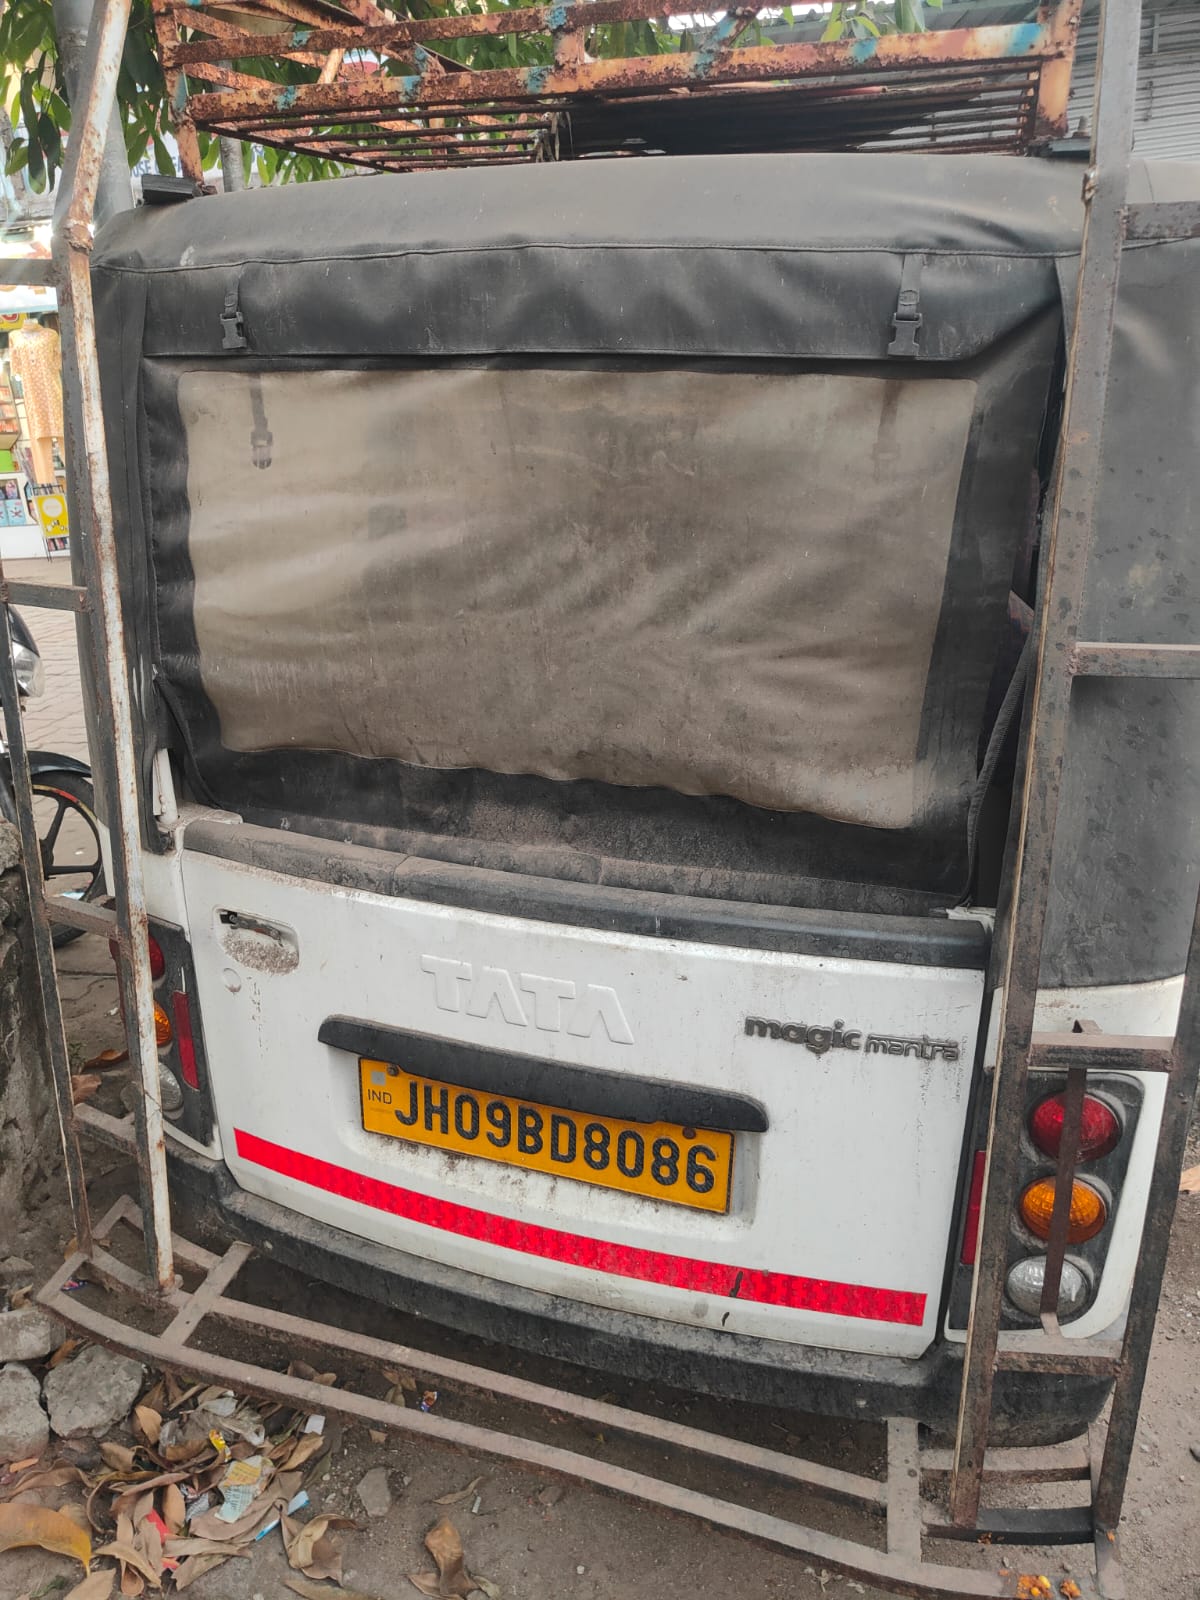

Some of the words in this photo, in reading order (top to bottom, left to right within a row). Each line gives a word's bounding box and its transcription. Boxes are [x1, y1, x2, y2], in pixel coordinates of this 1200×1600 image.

[421, 954, 635, 1045] TATA
[744, 1016, 863, 1055] magic
[865, 1033, 960, 1062] mantra
[367, 1088, 392, 1105] IND
[394, 1080, 716, 1194] JH09BD8086
